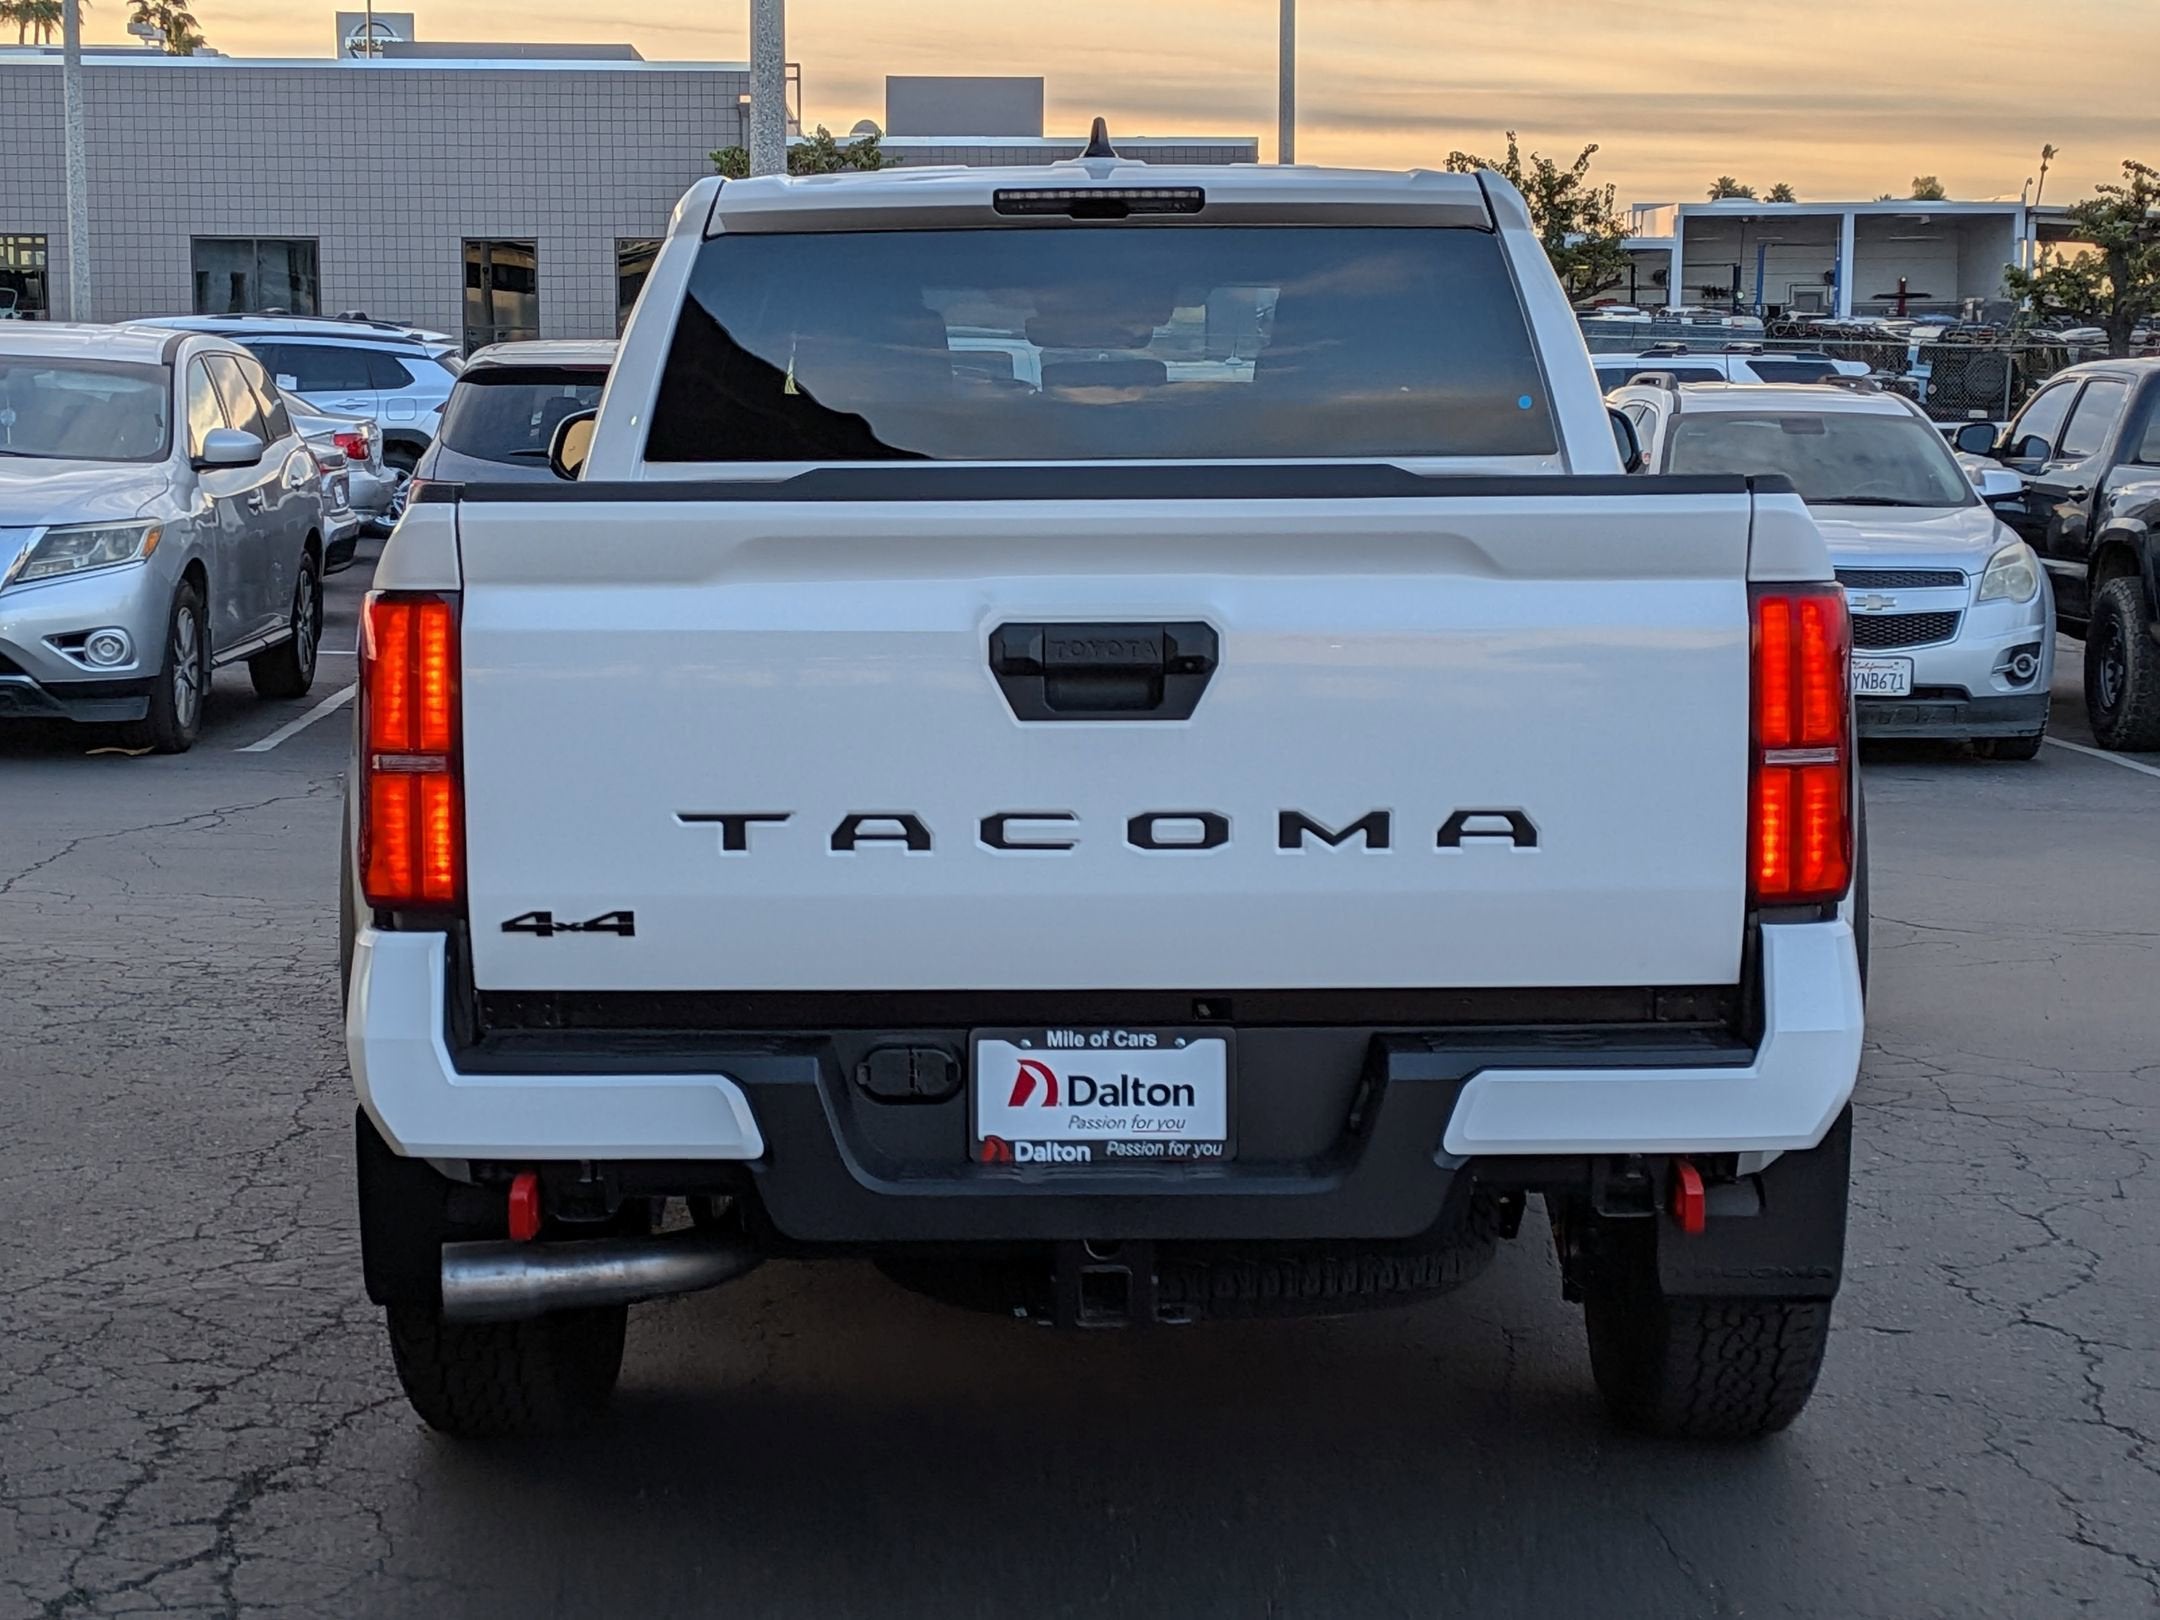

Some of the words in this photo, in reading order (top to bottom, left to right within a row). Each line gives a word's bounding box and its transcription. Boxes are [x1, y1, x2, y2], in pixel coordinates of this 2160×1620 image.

[1050, 640, 1158, 657] TOYOTA
[675, 810, 1538, 852] TACOMA
[1046, 1030, 1085, 1047] Mile
[1089, 1030, 1111, 1048] of
[1113, 1030, 1158, 1047] Cars
[1068, 1074, 1195, 1107] Dalton
[1067, 1115, 1127, 1130] Passion
[1131, 1114, 1156, 1130] for
[1156, 1118, 1187, 1132] you
[1014, 1141, 1092, 1162] Dalton
[1106, 1141, 1165, 1156] Passion
[1168, 1140, 1192, 1156] for
[1192, 1143, 1223, 1159] you
